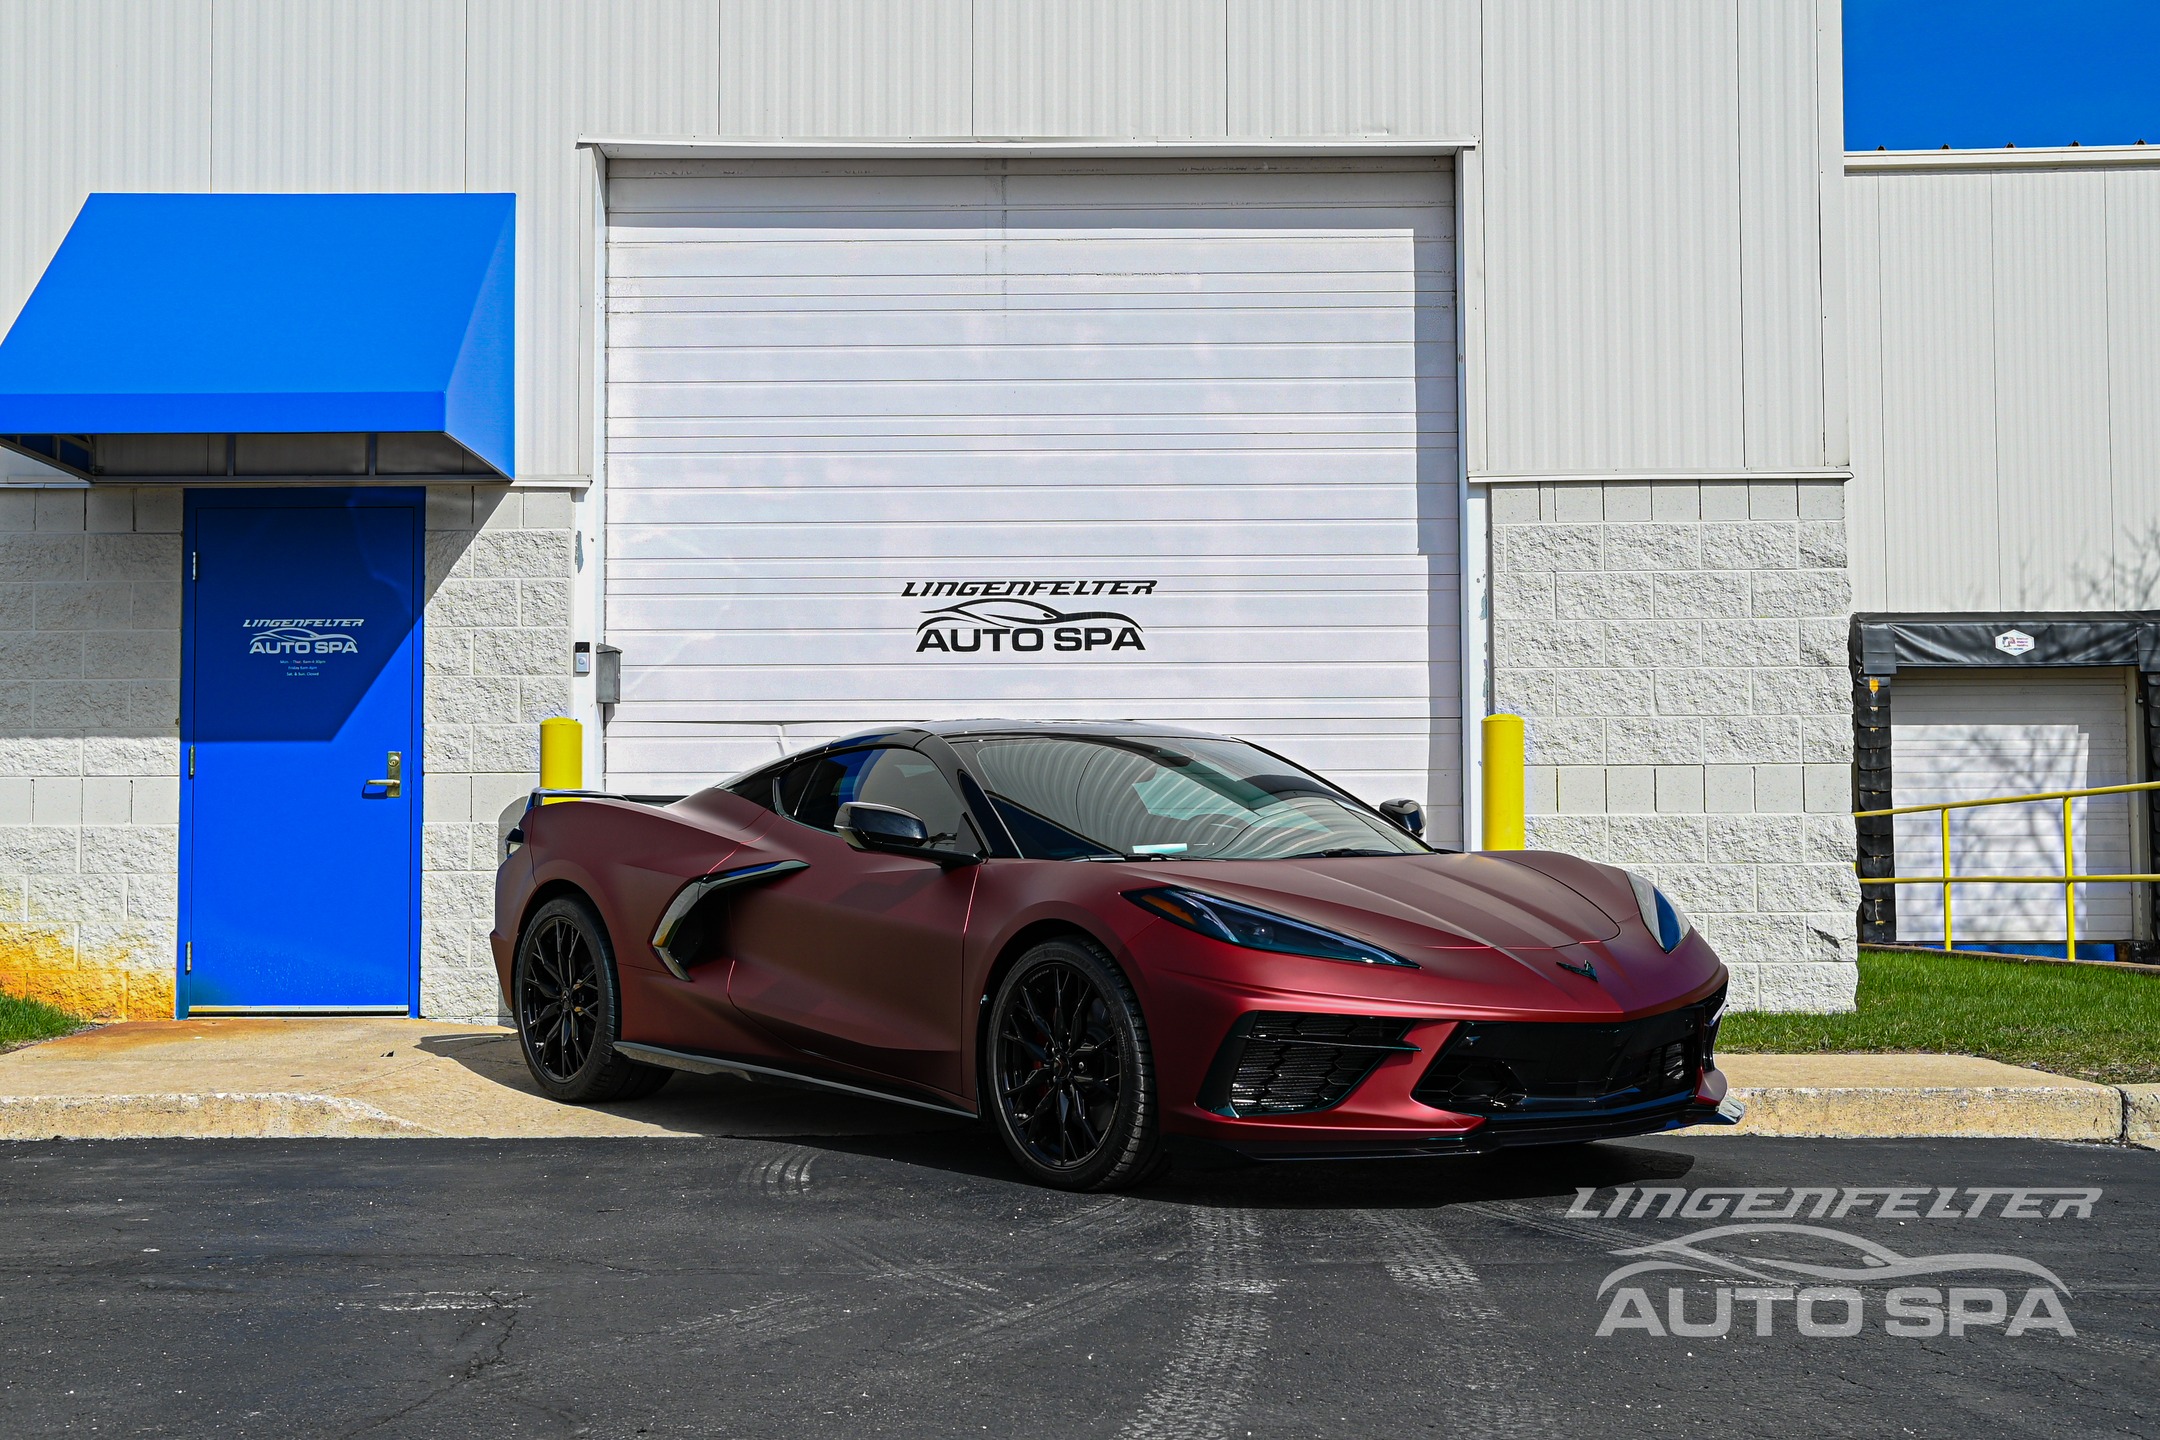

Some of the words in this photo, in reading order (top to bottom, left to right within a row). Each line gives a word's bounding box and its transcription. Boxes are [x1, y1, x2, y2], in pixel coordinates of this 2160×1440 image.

[901, 580, 1158, 597] LINGENFELTER
[242, 618, 365, 628] LINGENFELTER
[915, 627, 1044, 652] AUTO
[1053, 627, 1146, 652] SPA
[249, 641, 311, 654] AUTO
[314, 641, 358, 654] SPA
